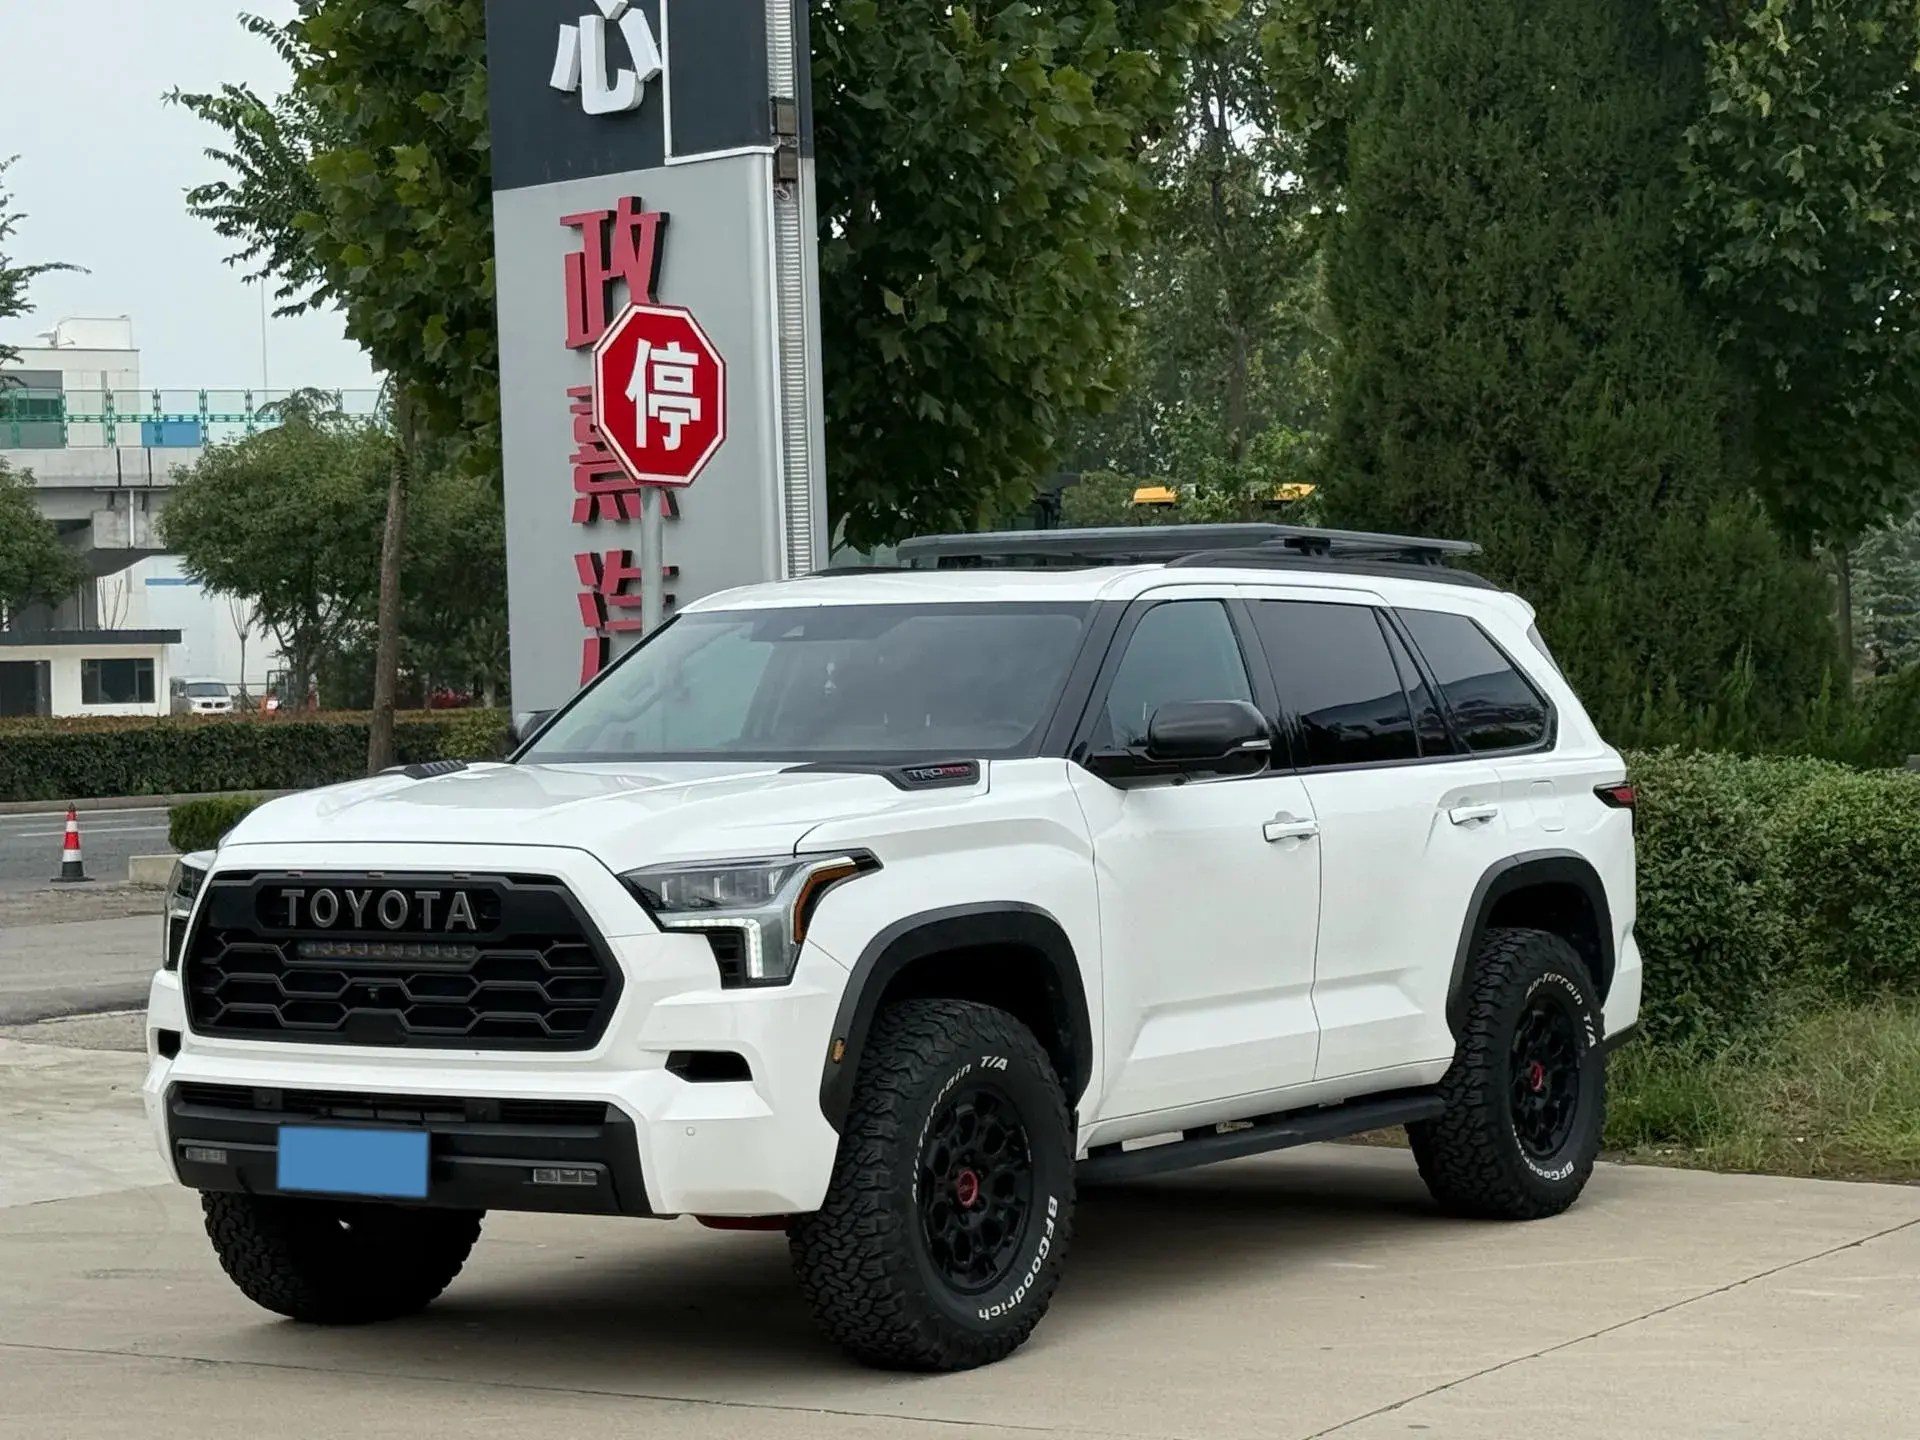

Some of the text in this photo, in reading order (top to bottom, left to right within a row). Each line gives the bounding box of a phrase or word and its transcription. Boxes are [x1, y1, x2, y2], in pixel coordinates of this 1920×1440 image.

[550, 0, 663, 115] 心
[625, 337, 701, 451] 停
[281, 888, 477, 931] TOYOTA
[981, 1055, 1008, 1071] T/A
[1583, 1011, 1597, 1048] T/A
[978, 1195, 1058, 1320] BFGoodrich
